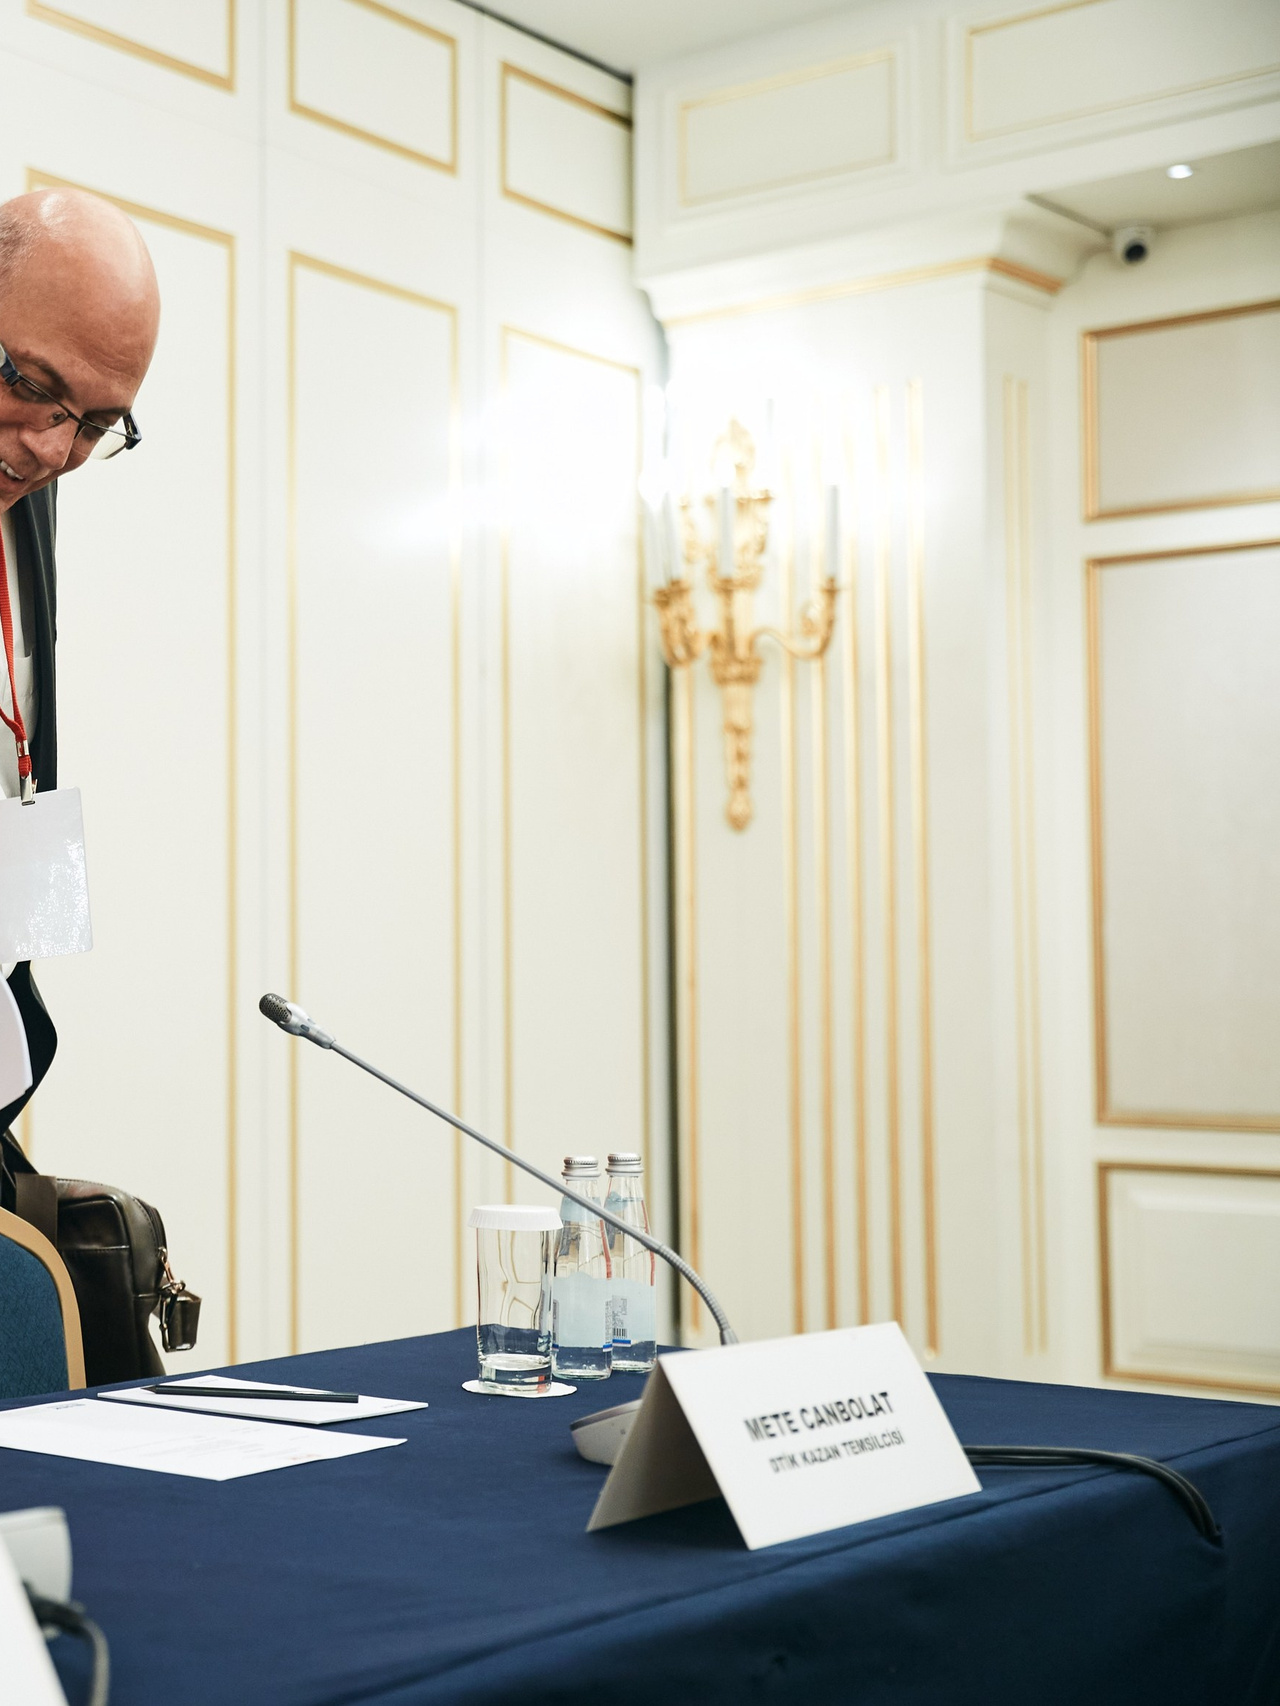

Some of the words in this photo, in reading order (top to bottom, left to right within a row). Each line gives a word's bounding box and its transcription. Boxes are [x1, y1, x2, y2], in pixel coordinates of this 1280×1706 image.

[743, 1410, 800, 1442] METE
[799, 1391, 895, 1430] CANBOLAT
[768, 1452, 800, 1474] DTİK
[801, 1444, 842, 1466] KAZAN
[841, 1427, 906, 1456] TEMSİLCİSİ
